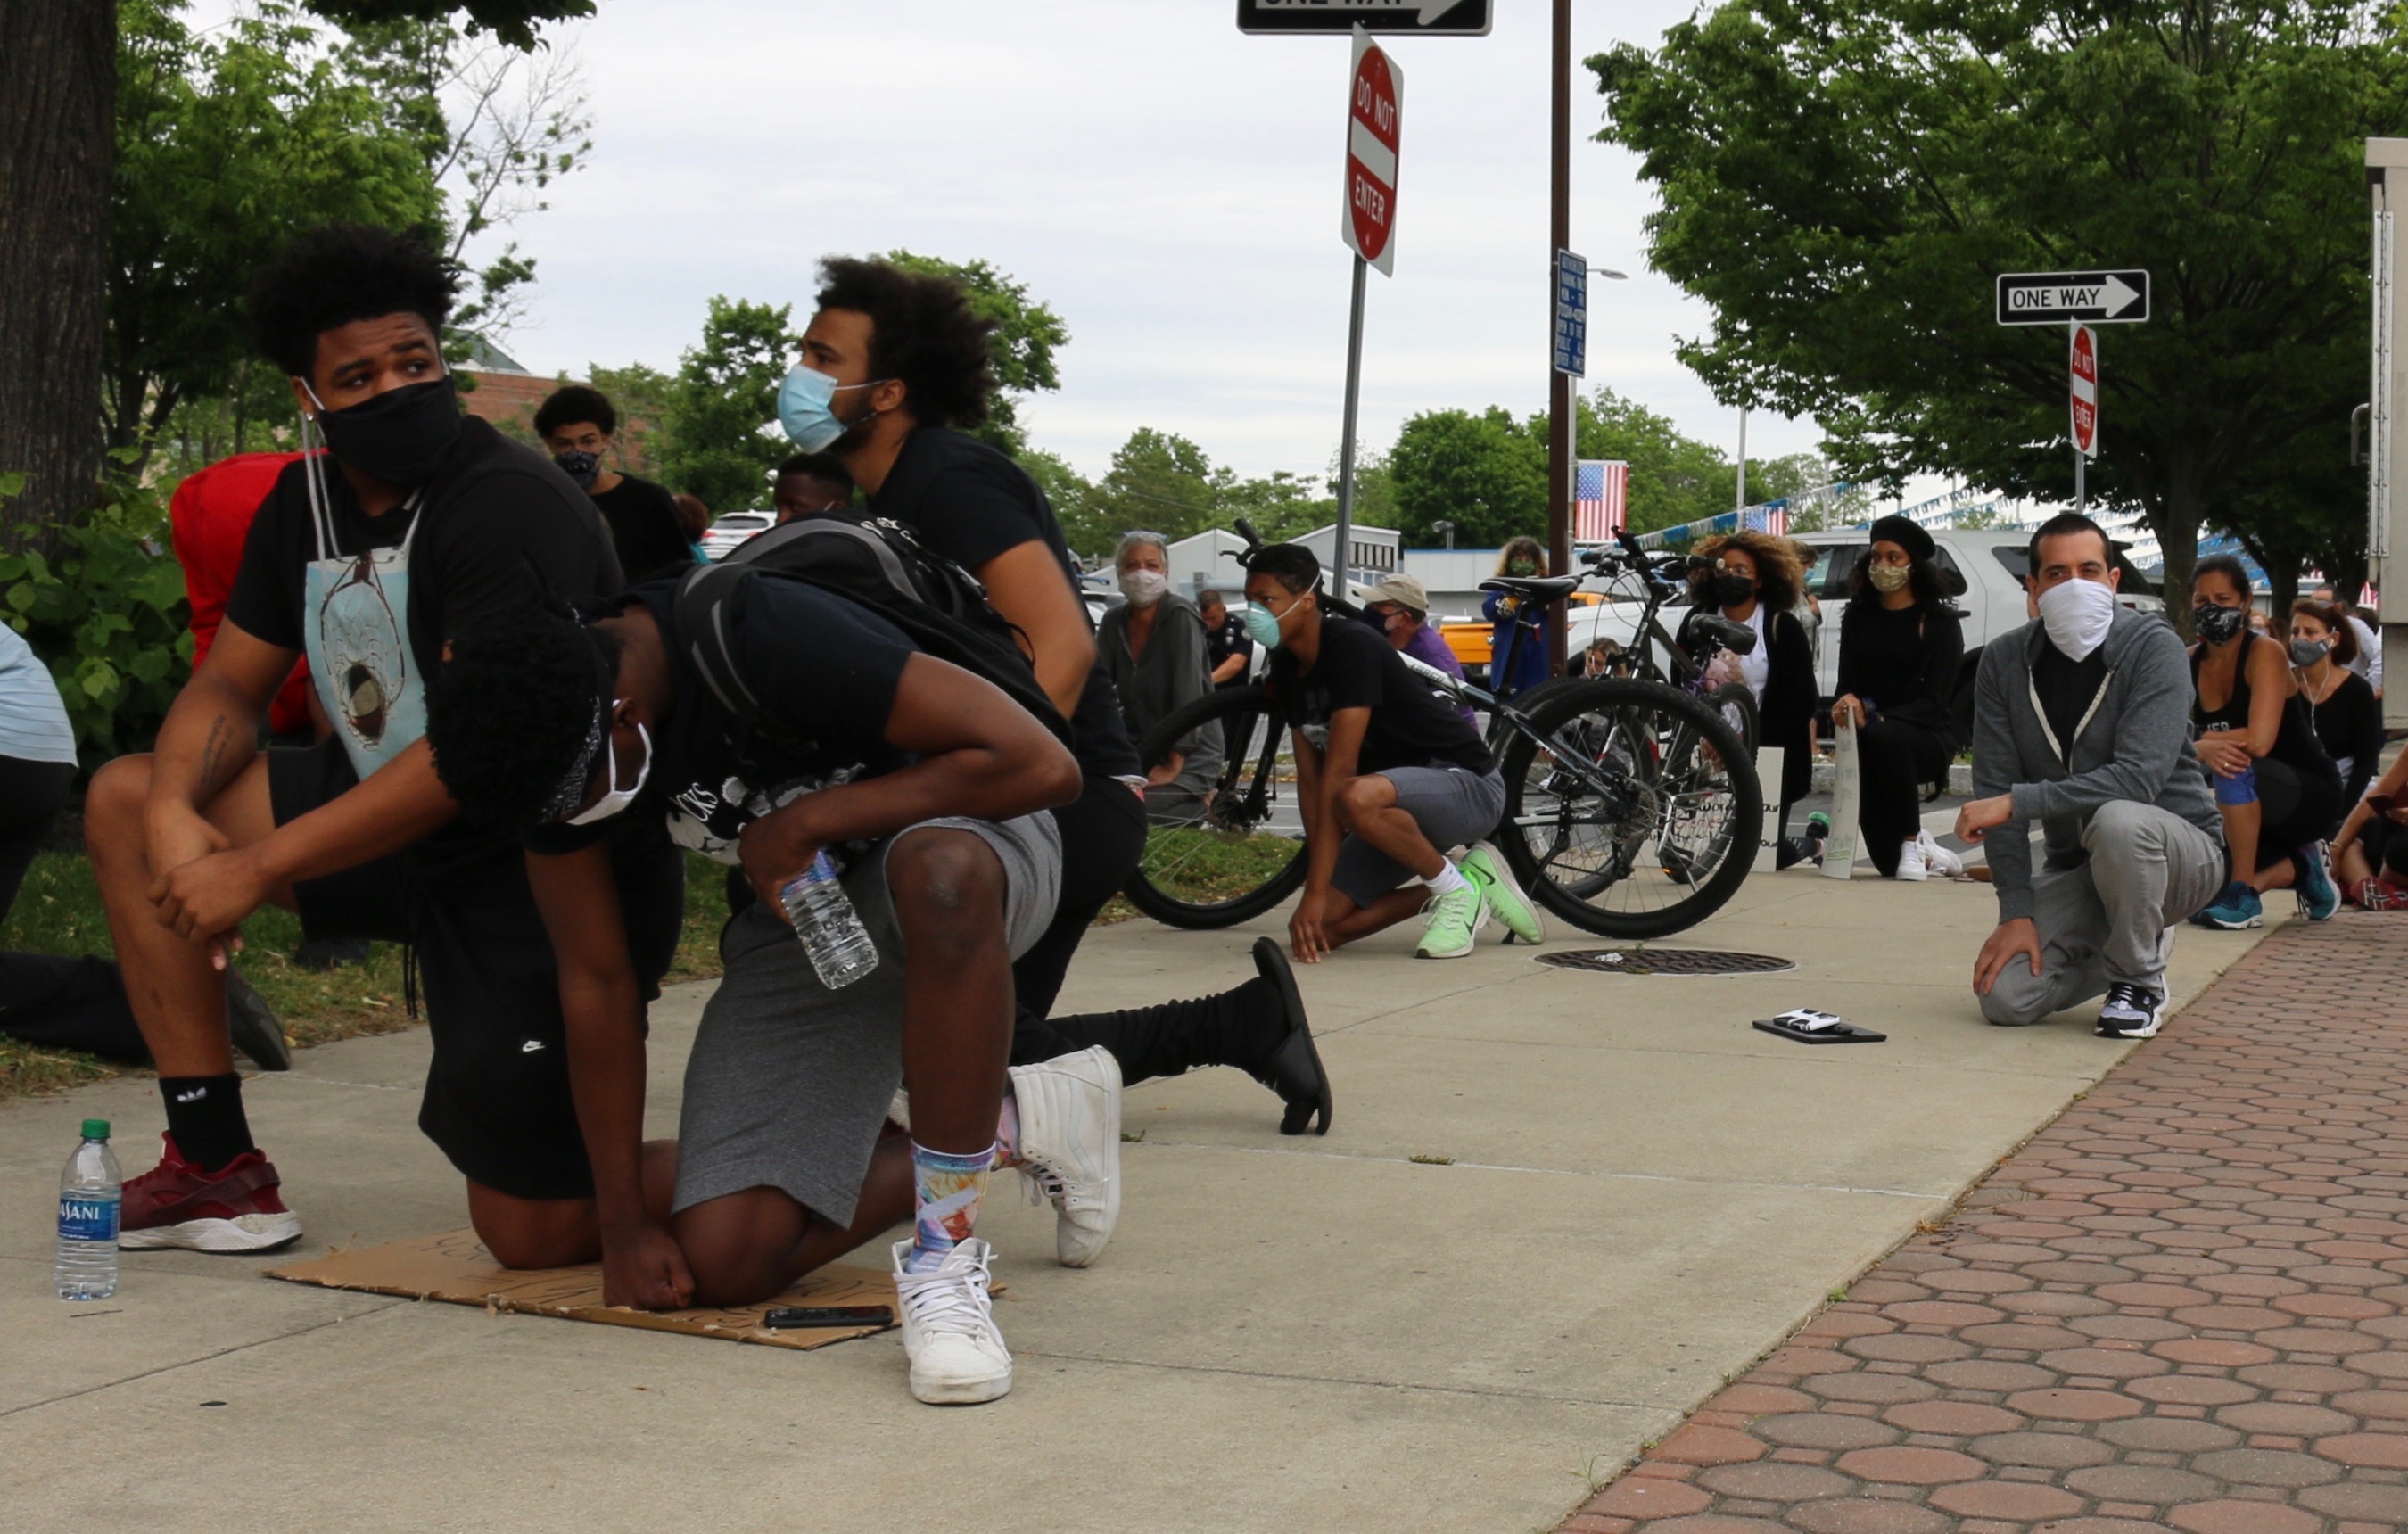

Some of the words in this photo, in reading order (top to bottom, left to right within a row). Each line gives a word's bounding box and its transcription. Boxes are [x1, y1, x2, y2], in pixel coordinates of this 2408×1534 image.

[1357, 75, 1371, 114] DO
[1374, 93, 1395, 136] NOT
[1355, 174, 1385, 226] ENTER
[2013, 289, 2052, 309] ONE
[2060, 287, 2100, 307] WAY
